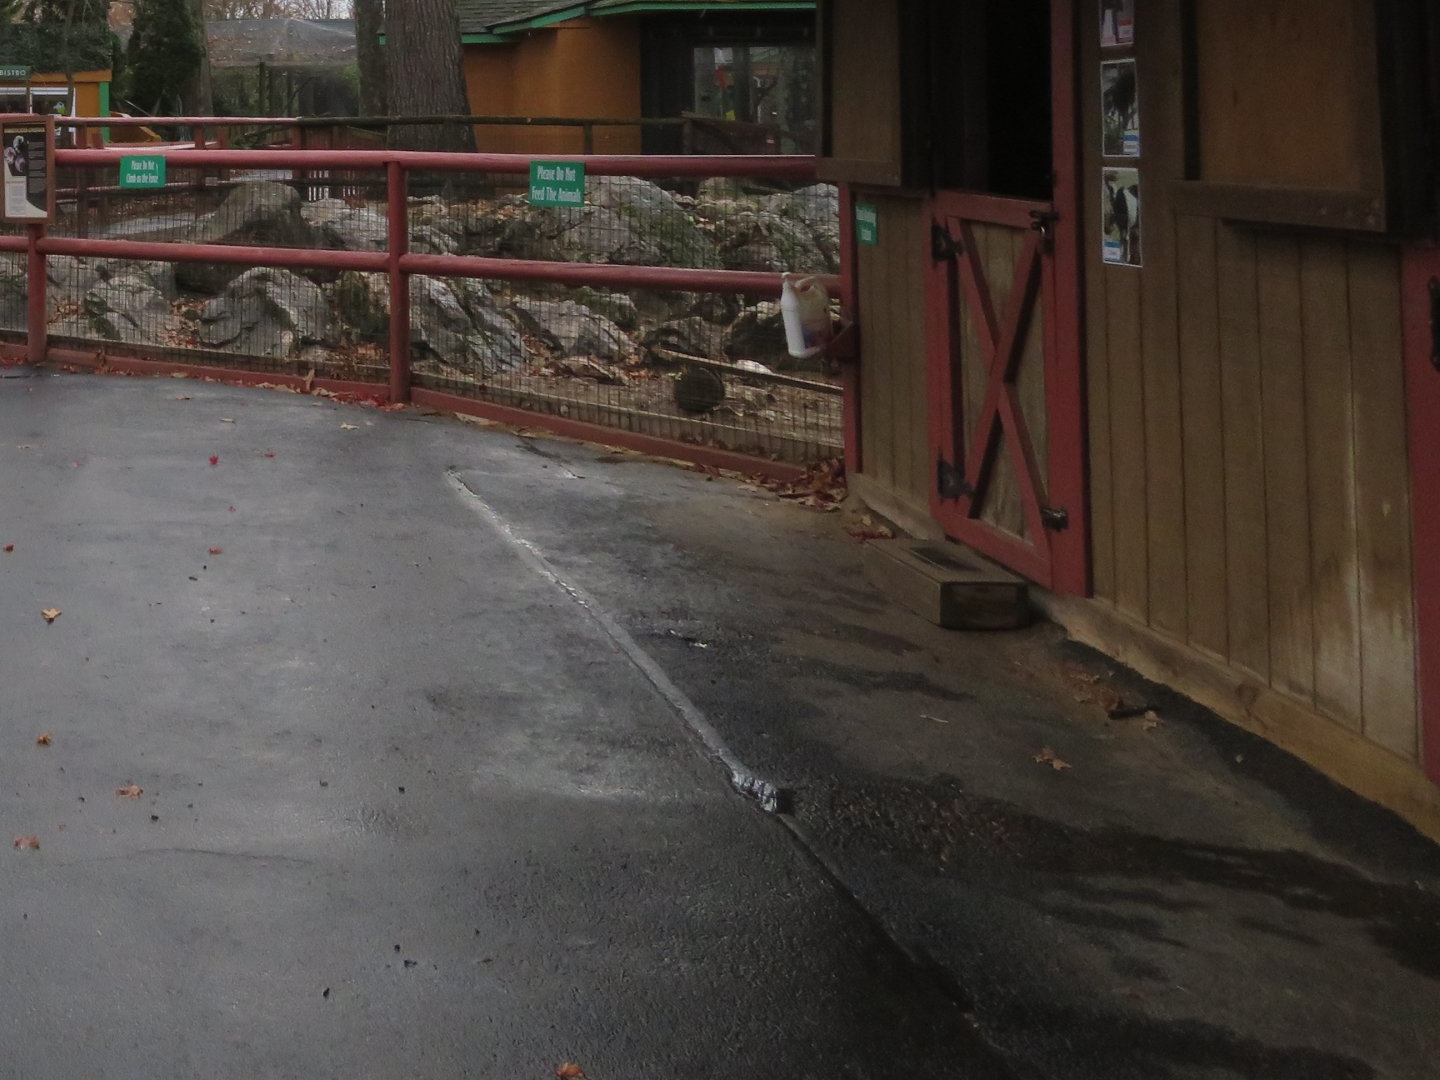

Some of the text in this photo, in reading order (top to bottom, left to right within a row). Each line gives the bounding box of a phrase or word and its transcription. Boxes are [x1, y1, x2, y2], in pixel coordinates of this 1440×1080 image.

[537, 165, 576, 182] Please Do Not
[532, 186, 581, 202] Feed The Animals
